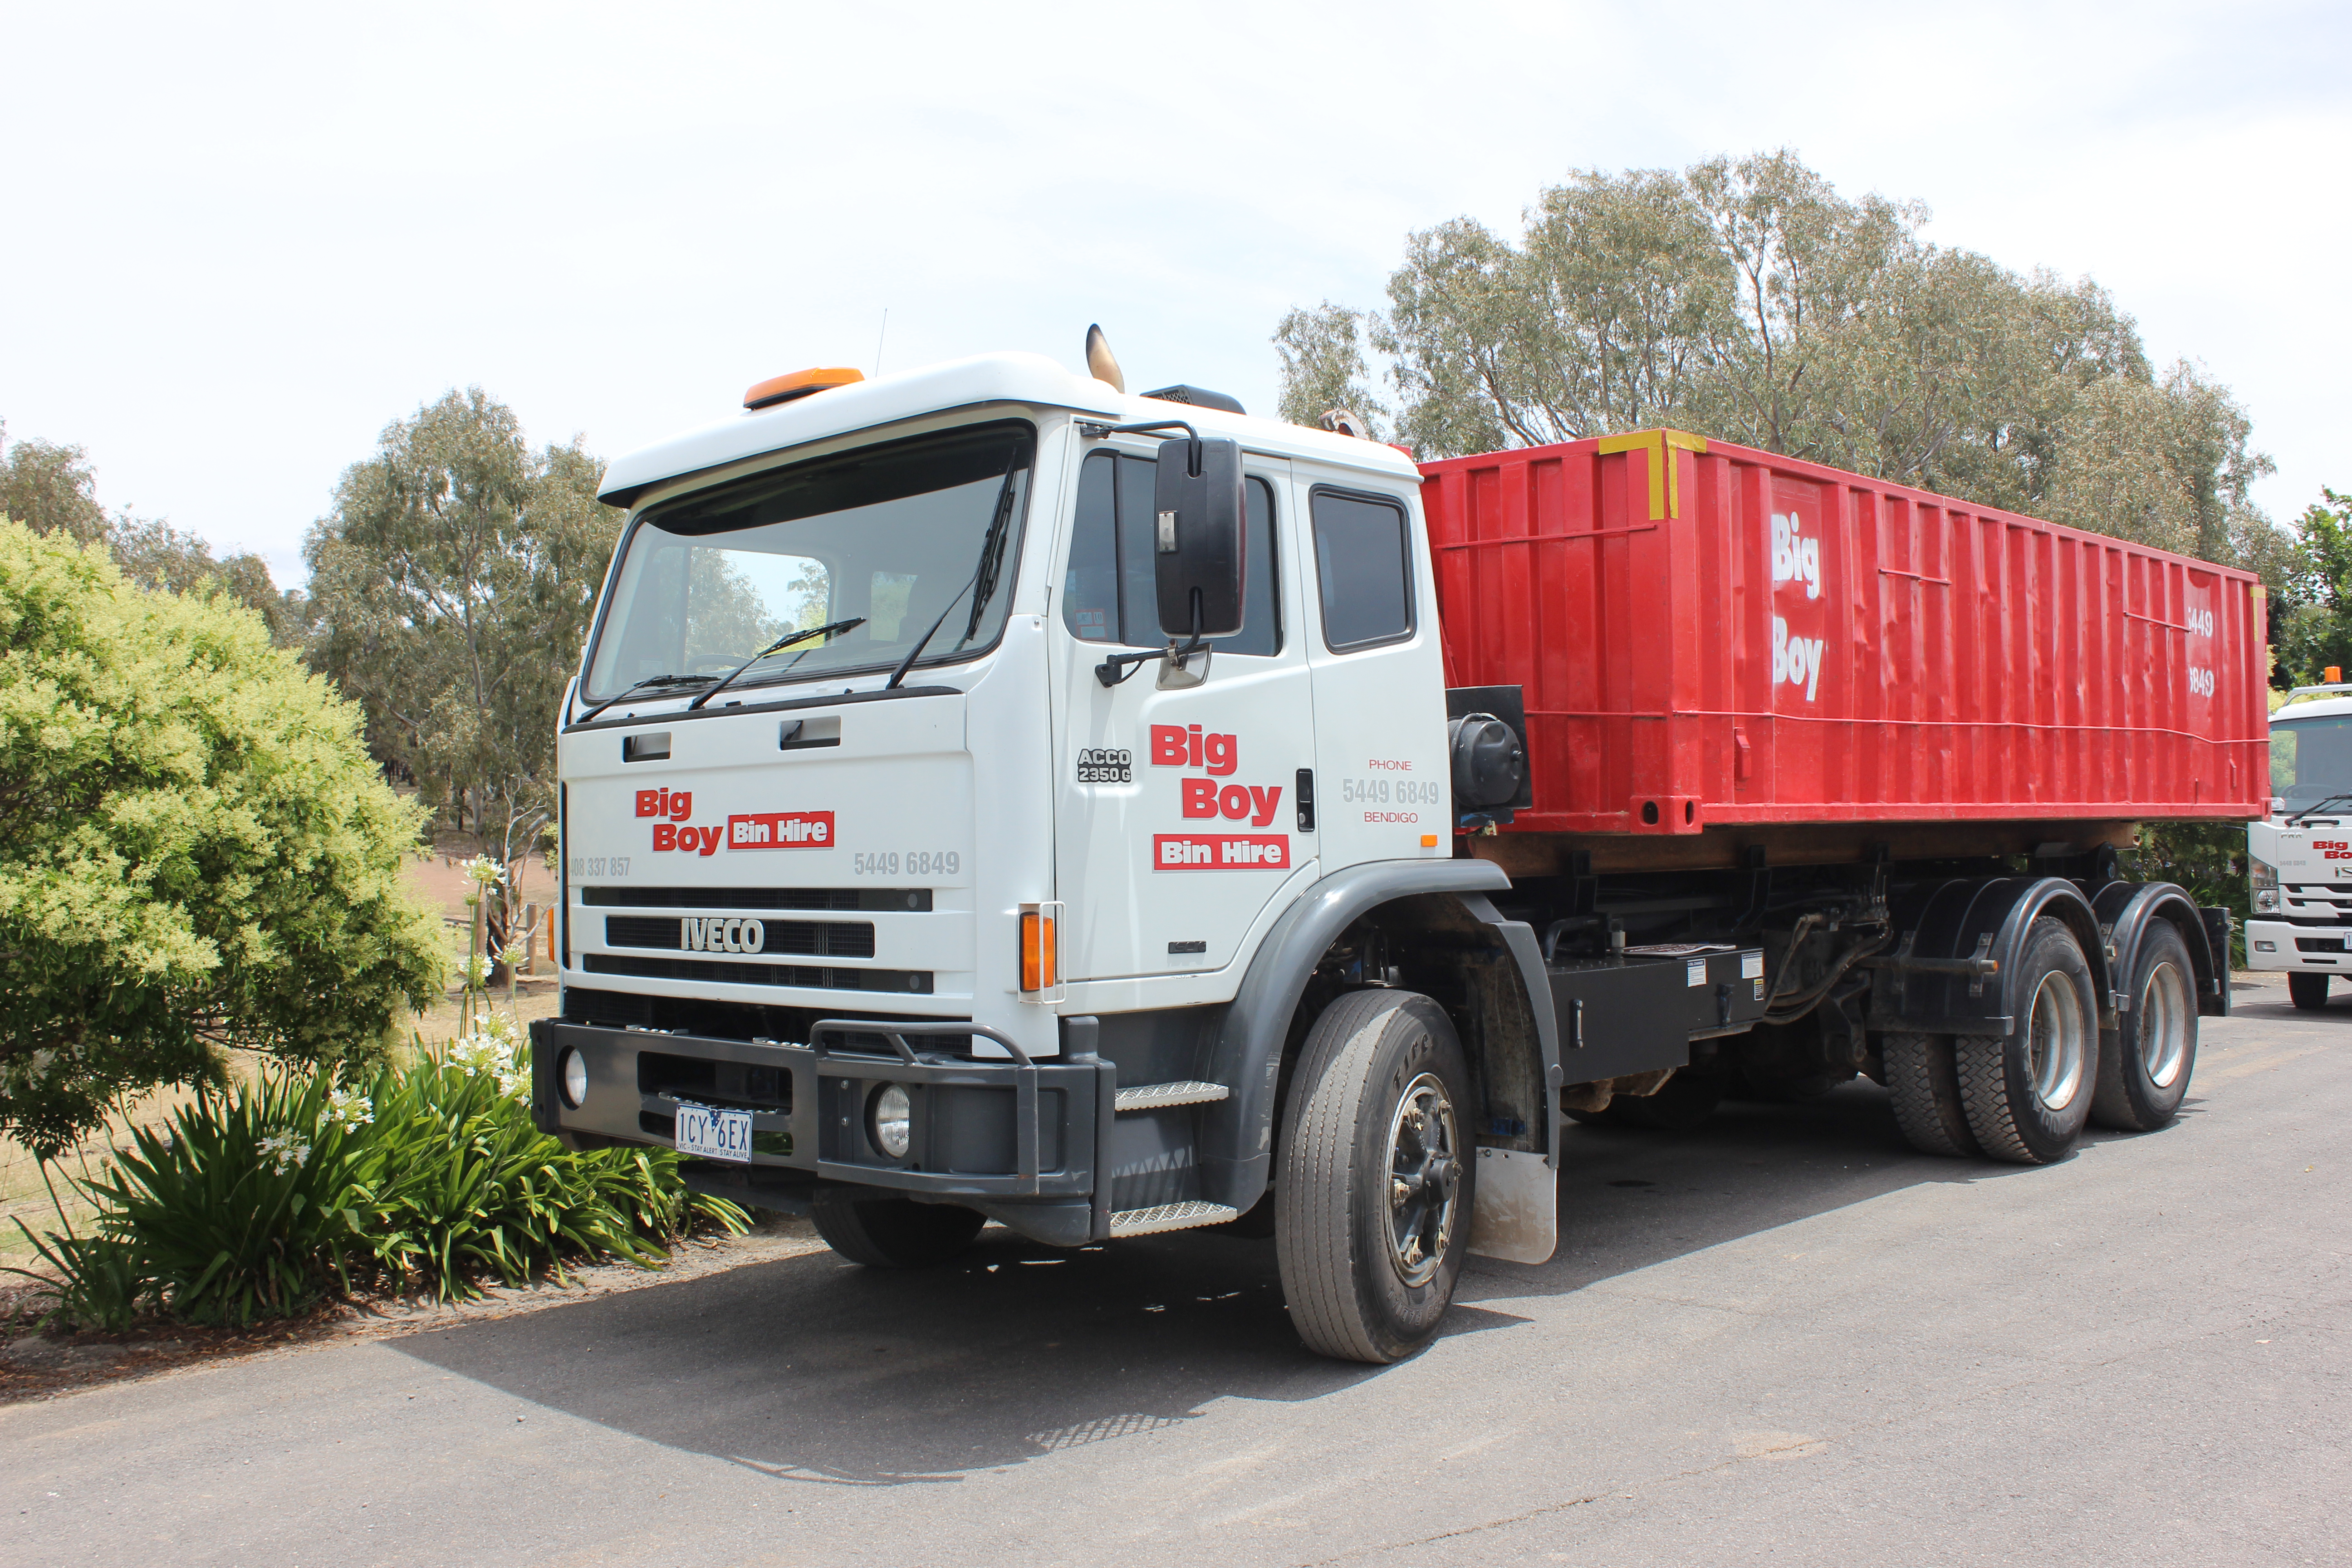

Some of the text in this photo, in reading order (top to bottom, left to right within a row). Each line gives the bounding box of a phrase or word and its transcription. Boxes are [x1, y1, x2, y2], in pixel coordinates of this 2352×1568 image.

[1771, 511, 1820, 599] Big
[1772, 616, 1823, 701] Boy
[1078, 750, 1131, 764] ACCO
[1151, 724, 1238, 776] Big
[1369, 759, 1412, 771] PHONE
[636, 787, 692, 821] Big
[1182, 778, 1283, 827] Boy
[1343, 778, 1439, 805] 5449 6849
[733, 818, 828, 843] Bin Hire
[1364, 811, 1418, 823] BENDIGO
[653, 823, 723, 856] Boy
[1161, 840, 1282, 864] Bin Hire
[2313, 841, 2348, 851] Big
[588, 857, 607, 877] 337
[610, 857, 631, 877] 857
[854, 851, 960, 875] 5449 6849
[681, 918, 764, 953] IVECO
[681, 1113, 748, 1151] 1CY 6EX
